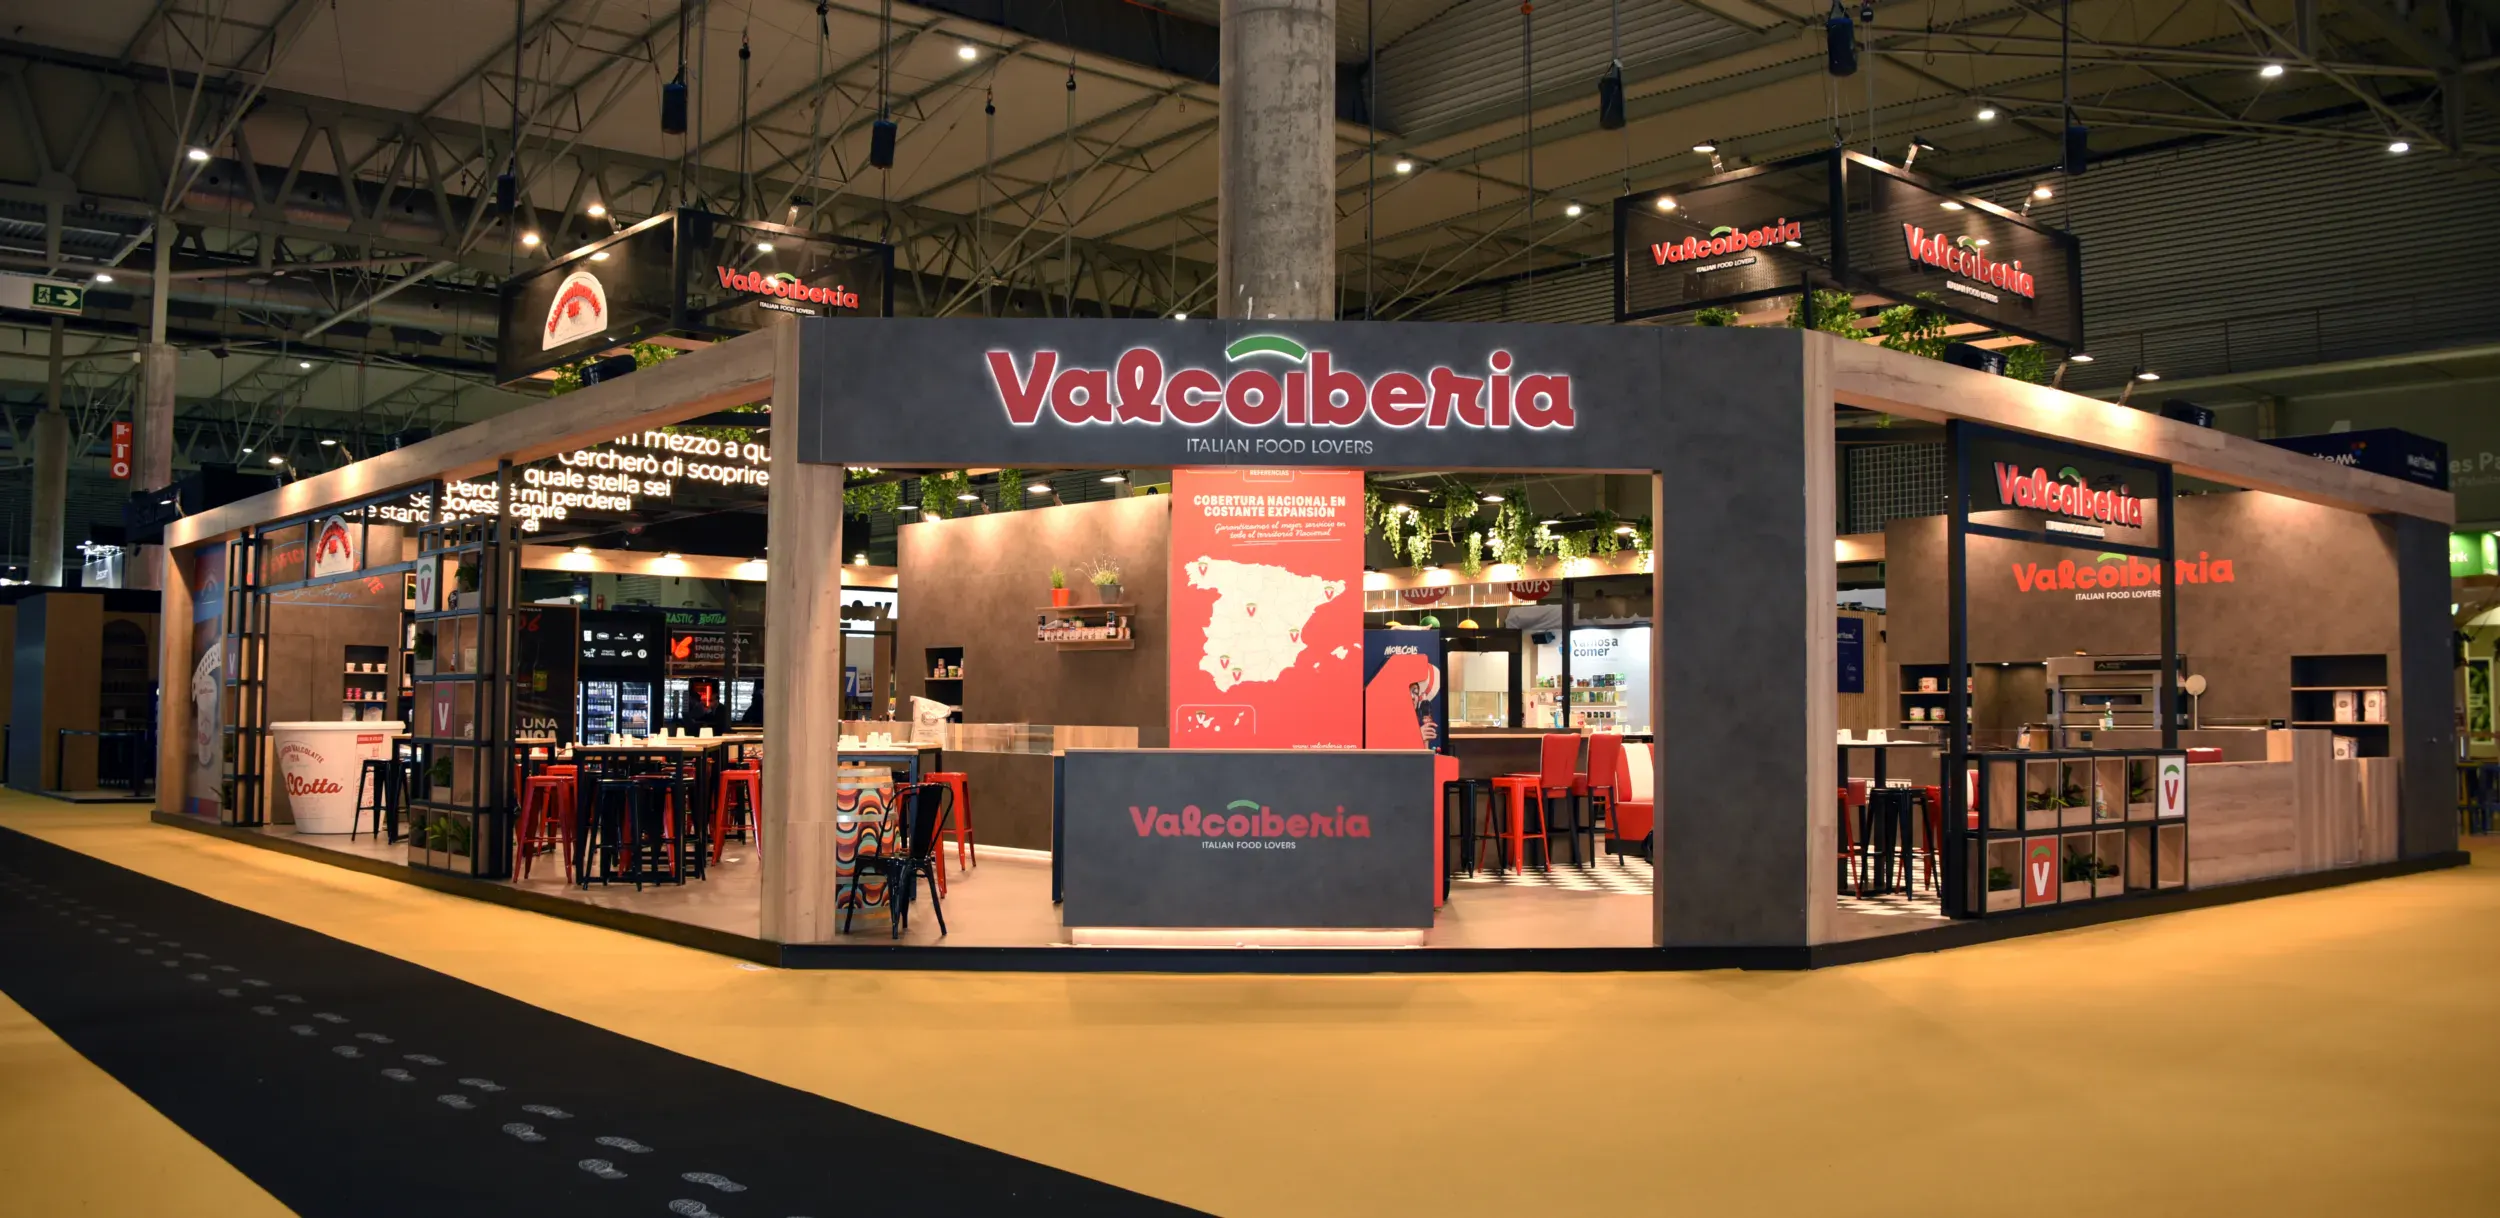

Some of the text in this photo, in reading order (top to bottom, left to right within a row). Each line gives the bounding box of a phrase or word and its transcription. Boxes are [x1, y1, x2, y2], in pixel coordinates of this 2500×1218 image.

[1650, 217, 1801, 266] Valcoiberia
[1717, 261, 1733, 270] FOOD
[1903, 223, 2035, 299] Valcoiberia
[716, 265, 859, 309] Valcoiberia
[759, 301, 780, 311] ITALIAN
[780, 303, 795, 313] FOOD
[985, 347, 1575, 429] Valcoiberia
[644, 431, 721, 456] mezzo
[724, 440, 739, 458] a
[1186, 438, 1374, 455] ITALIAN FOOD LOVERS
[524, 467, 671, 497] quale stella sei
[662, 456, 683, 477] di
[687, 462, 769, 486] scoprire
[521, 487, 547, 503] mi
[552, 490, 631, 510] perderei
[1193, 494, 1346, 507] COBERTURA NACIONAL EN
[1994, 461, 2143, 527] Valcoiberia
[509, 502, 567, 520] capire
[1204, 504, 1335, 518] COSTANTE EXPANSIÓN
[2075, 589, 2161, 601] ITALIAN FOOD LOVERS
[1573, 648, 1610, 657] comer
[2164, 779, 2179, 810] V
[1128, 804, 1372, 838] Valcoiberia
[1202, 841, 1296, 850] ITALIAN FOOD LOVERS
[2032, 861, 2050, 897] V
